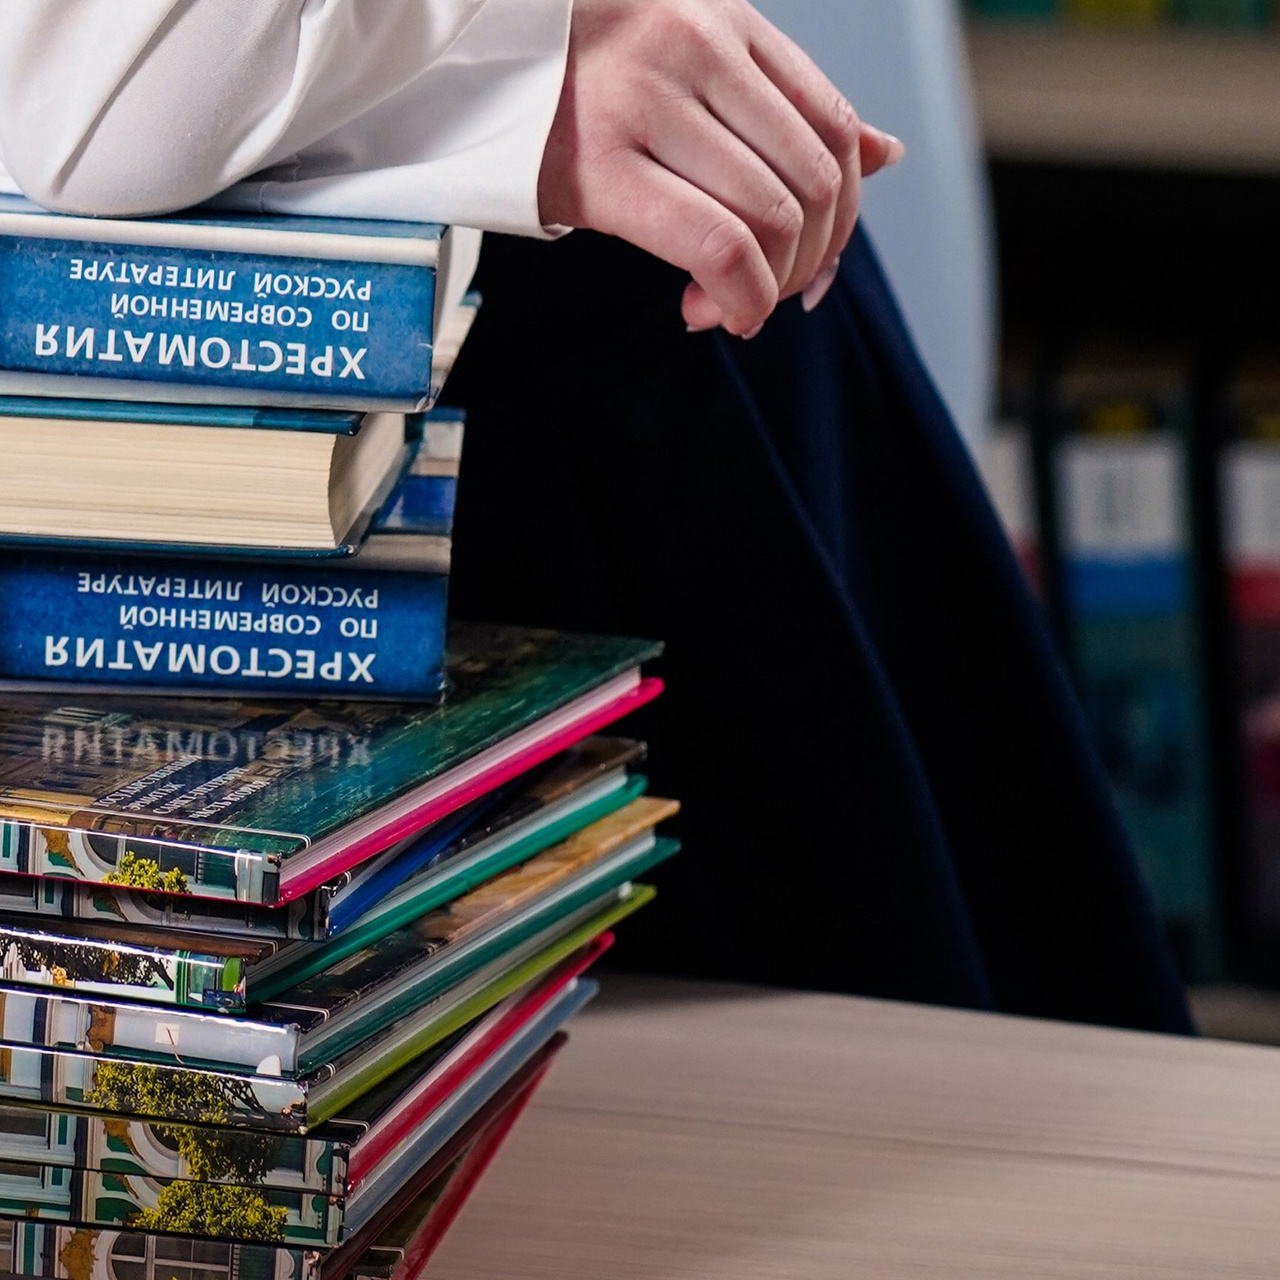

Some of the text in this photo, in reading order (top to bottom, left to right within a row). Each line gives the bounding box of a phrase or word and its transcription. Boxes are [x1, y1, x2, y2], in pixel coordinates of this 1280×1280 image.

[69, 259, 372, 301] РУССКОЙ ЛИТЕРАТУРЕ
[111, 293, 369, 332] ПО СОВРЕМЕННОЙ
[34, 323, 367, 380] ХРЕСТОМАТИЯ
[78, 573, 379, 607] РУССКОЙ ЛИТЕРАТУРЕ
[120, 606, 378, 638] ПО СОВРЕМЕННОЙ
[45, 636, 376, 683] ХРЕСТОМАТИЯ
